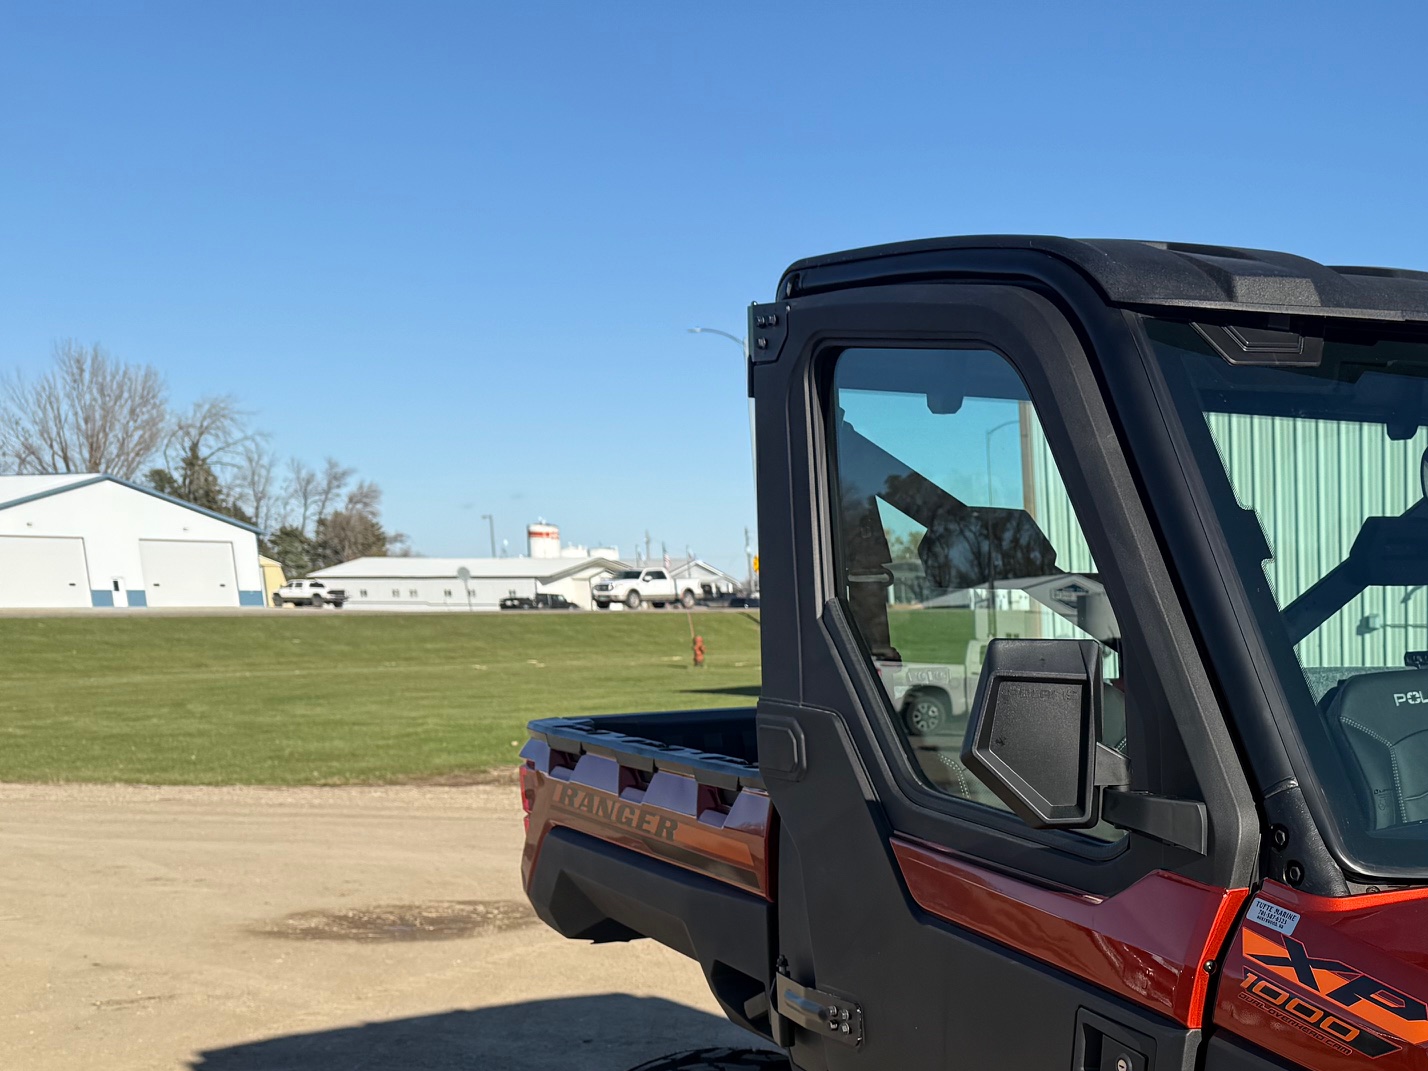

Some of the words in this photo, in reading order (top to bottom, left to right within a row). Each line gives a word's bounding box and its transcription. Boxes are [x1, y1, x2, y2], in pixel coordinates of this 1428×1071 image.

[559, 783, 679, 841] RANGER
[1238, 992, 1324, 1041] DUAL-OVERHEAD
[1325, 1039, 1352, 1056] CAM
[1239, 972, 1360, 1042] 1000
